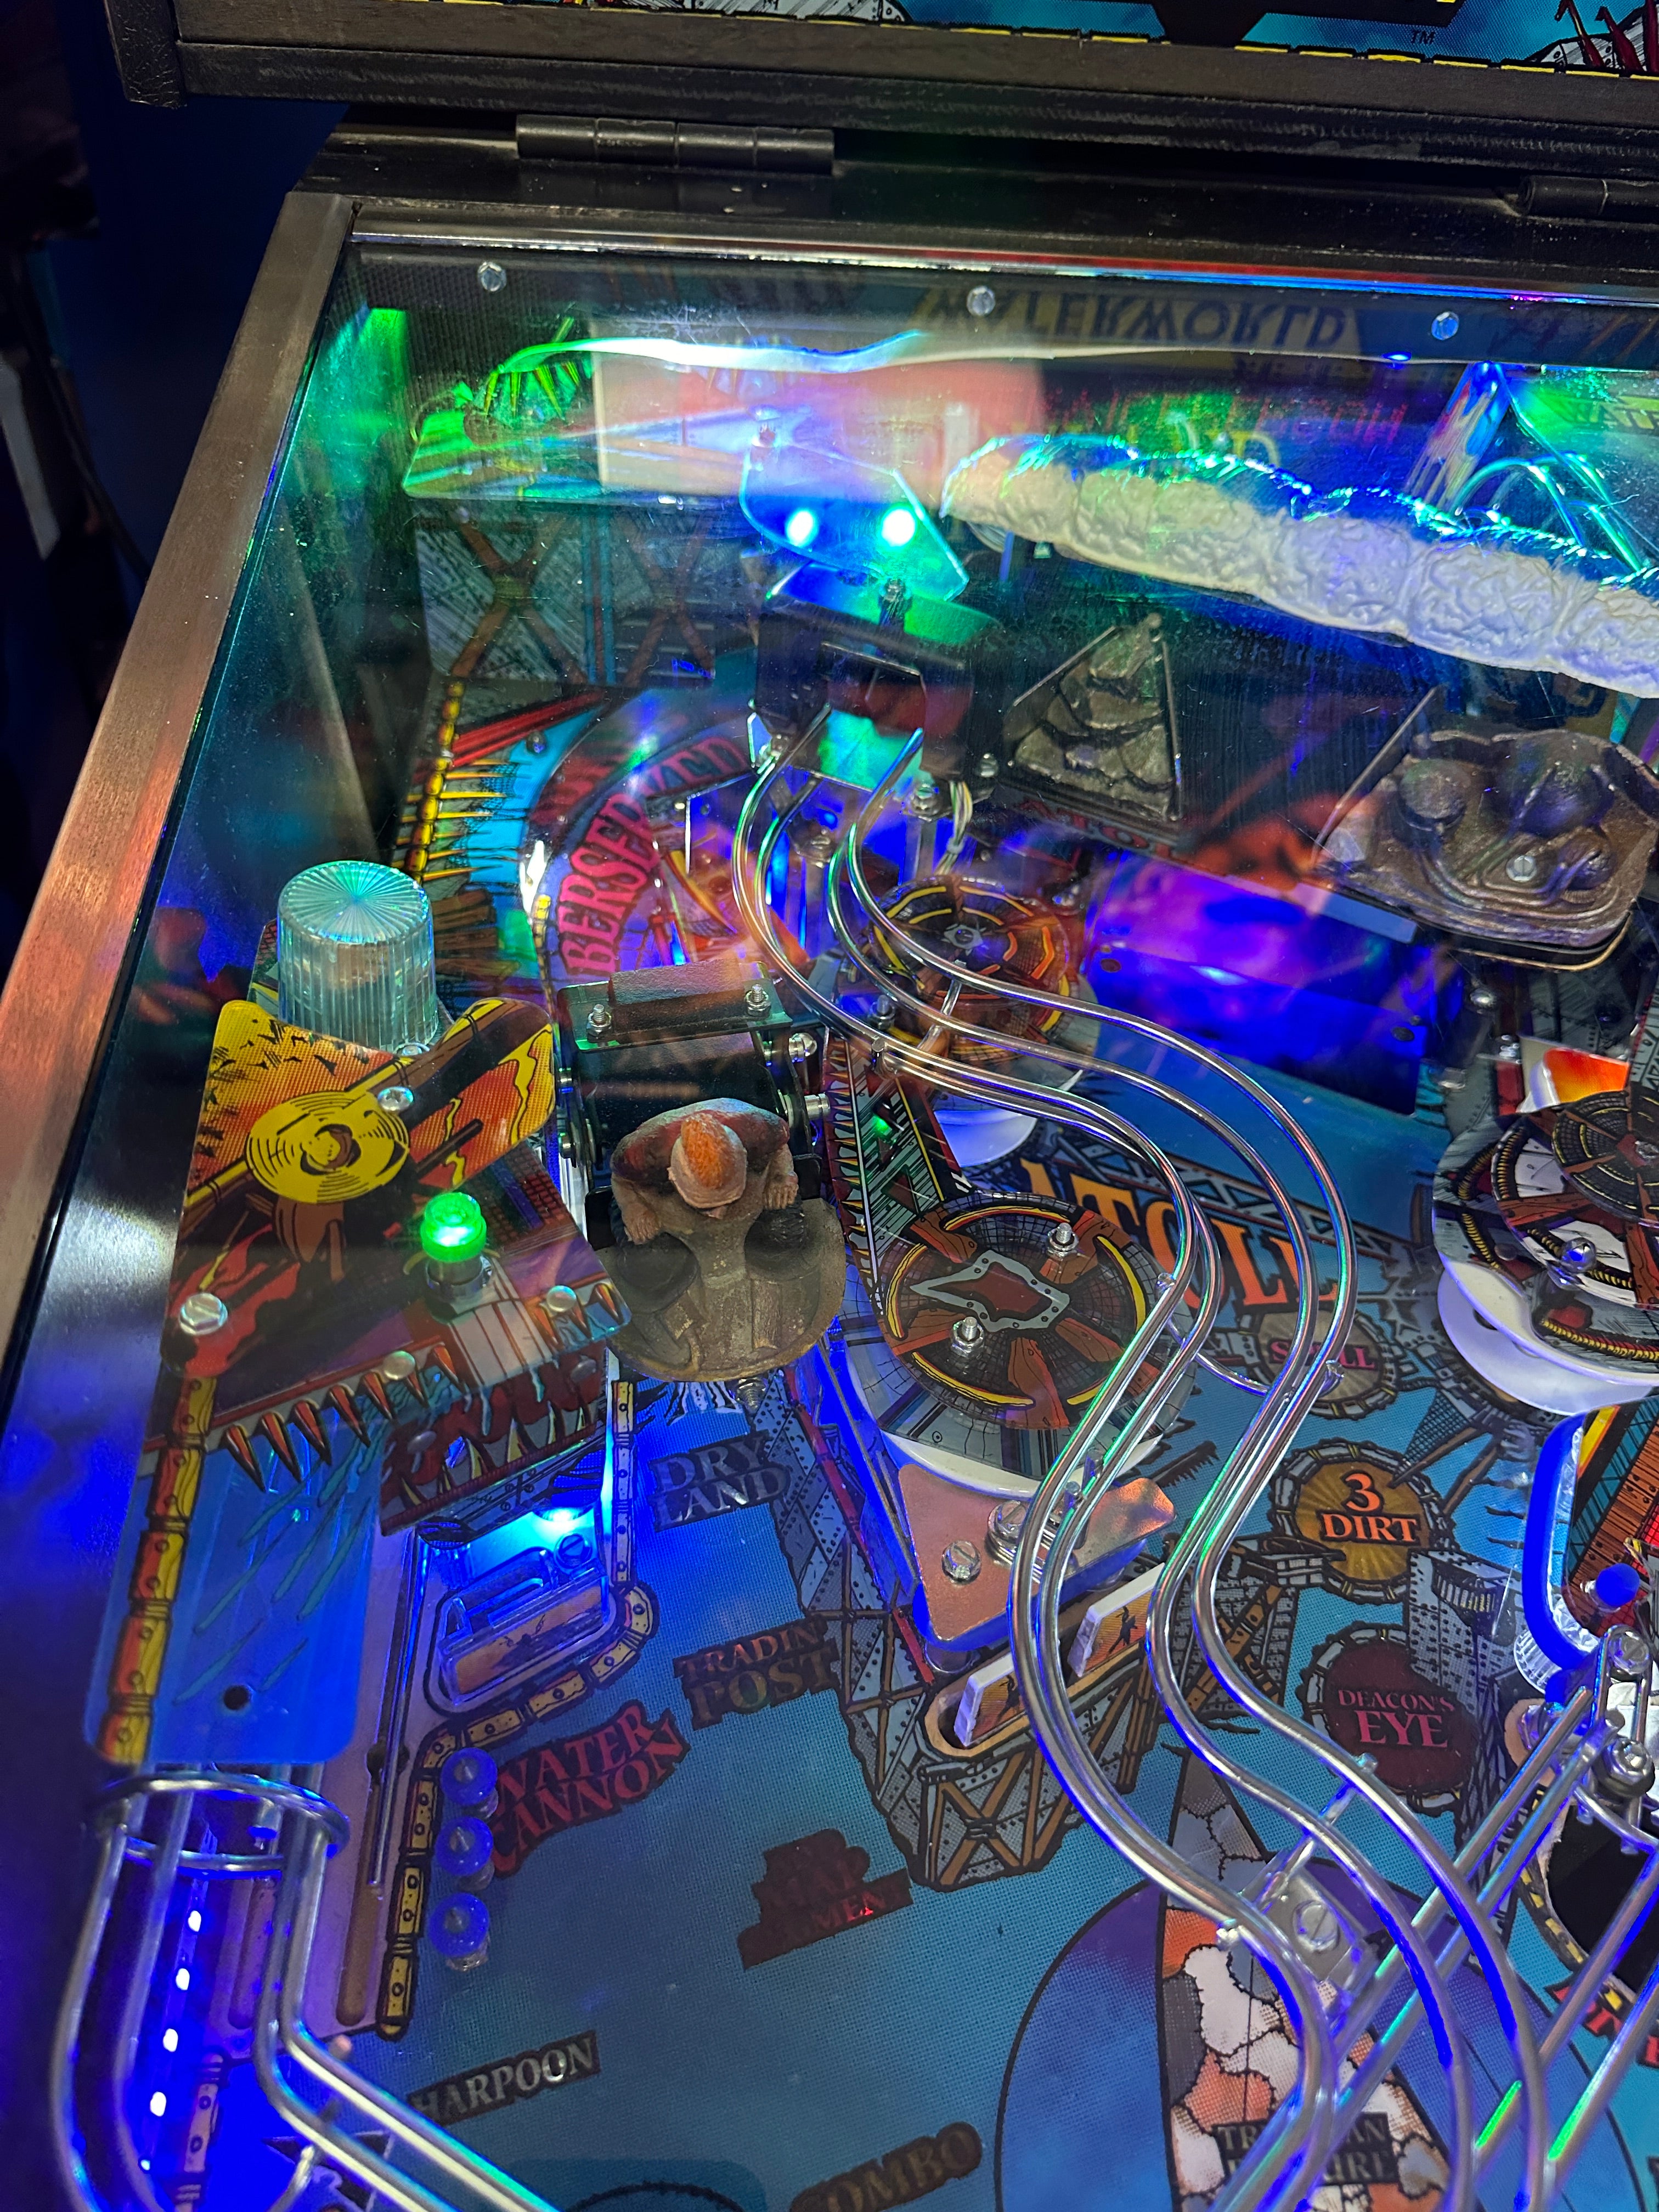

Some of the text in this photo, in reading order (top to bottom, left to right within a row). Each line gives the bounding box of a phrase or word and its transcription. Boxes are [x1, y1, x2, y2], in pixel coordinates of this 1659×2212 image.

[1410, 30, 1435, 45] TM
[654, 1435, 765, 1492] DRY
[650, 1466, 789, 1527] LAND
[1346, 1472, 1380, 1512] 3
[1322, 1513, 1418, 1542] DIRT
[690, 1646, 831, 1722] POST
[1338, 1689, 1455, 1712] DEACON'S
[1354, 1709, 1448, 1748] EYE
[411, 2038, 594, 2121] HARPOON
[803, 2131, 977, 2212] OMBO
